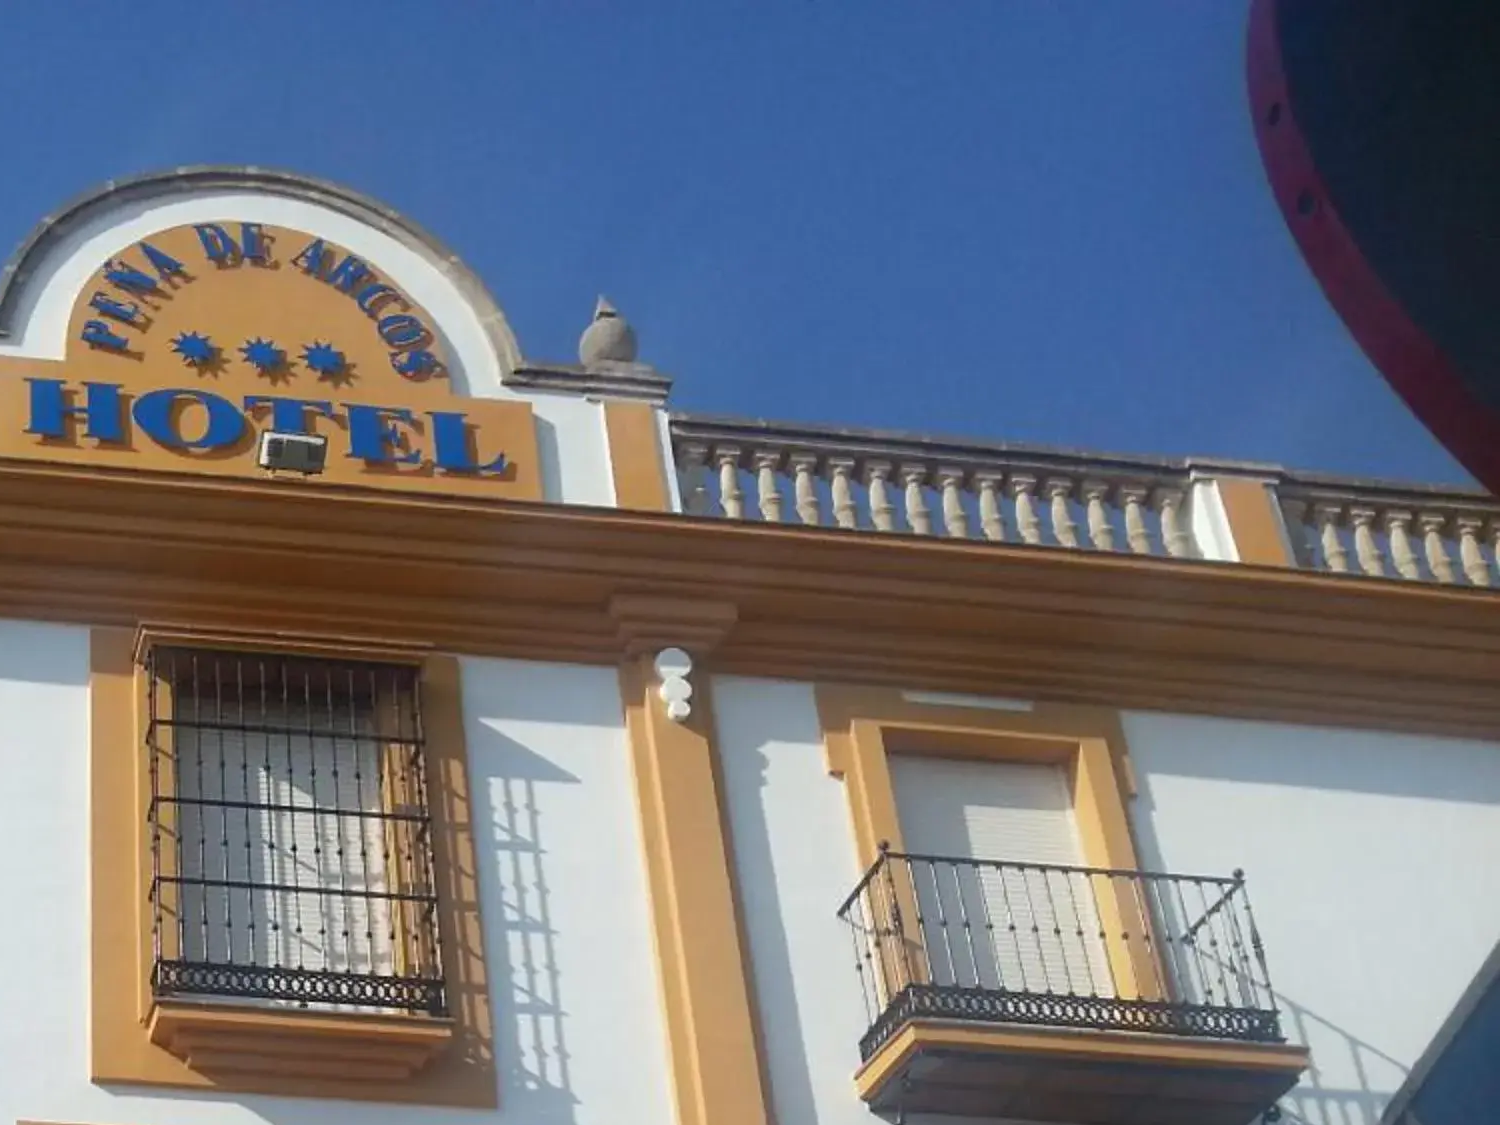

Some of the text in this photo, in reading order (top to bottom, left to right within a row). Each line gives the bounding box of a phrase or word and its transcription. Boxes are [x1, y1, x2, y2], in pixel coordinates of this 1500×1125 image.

[193, 222, 270, 265] DE
[291, 238, 441, 377] ARCOS
[23, 378, 507, 474] HOTEL
